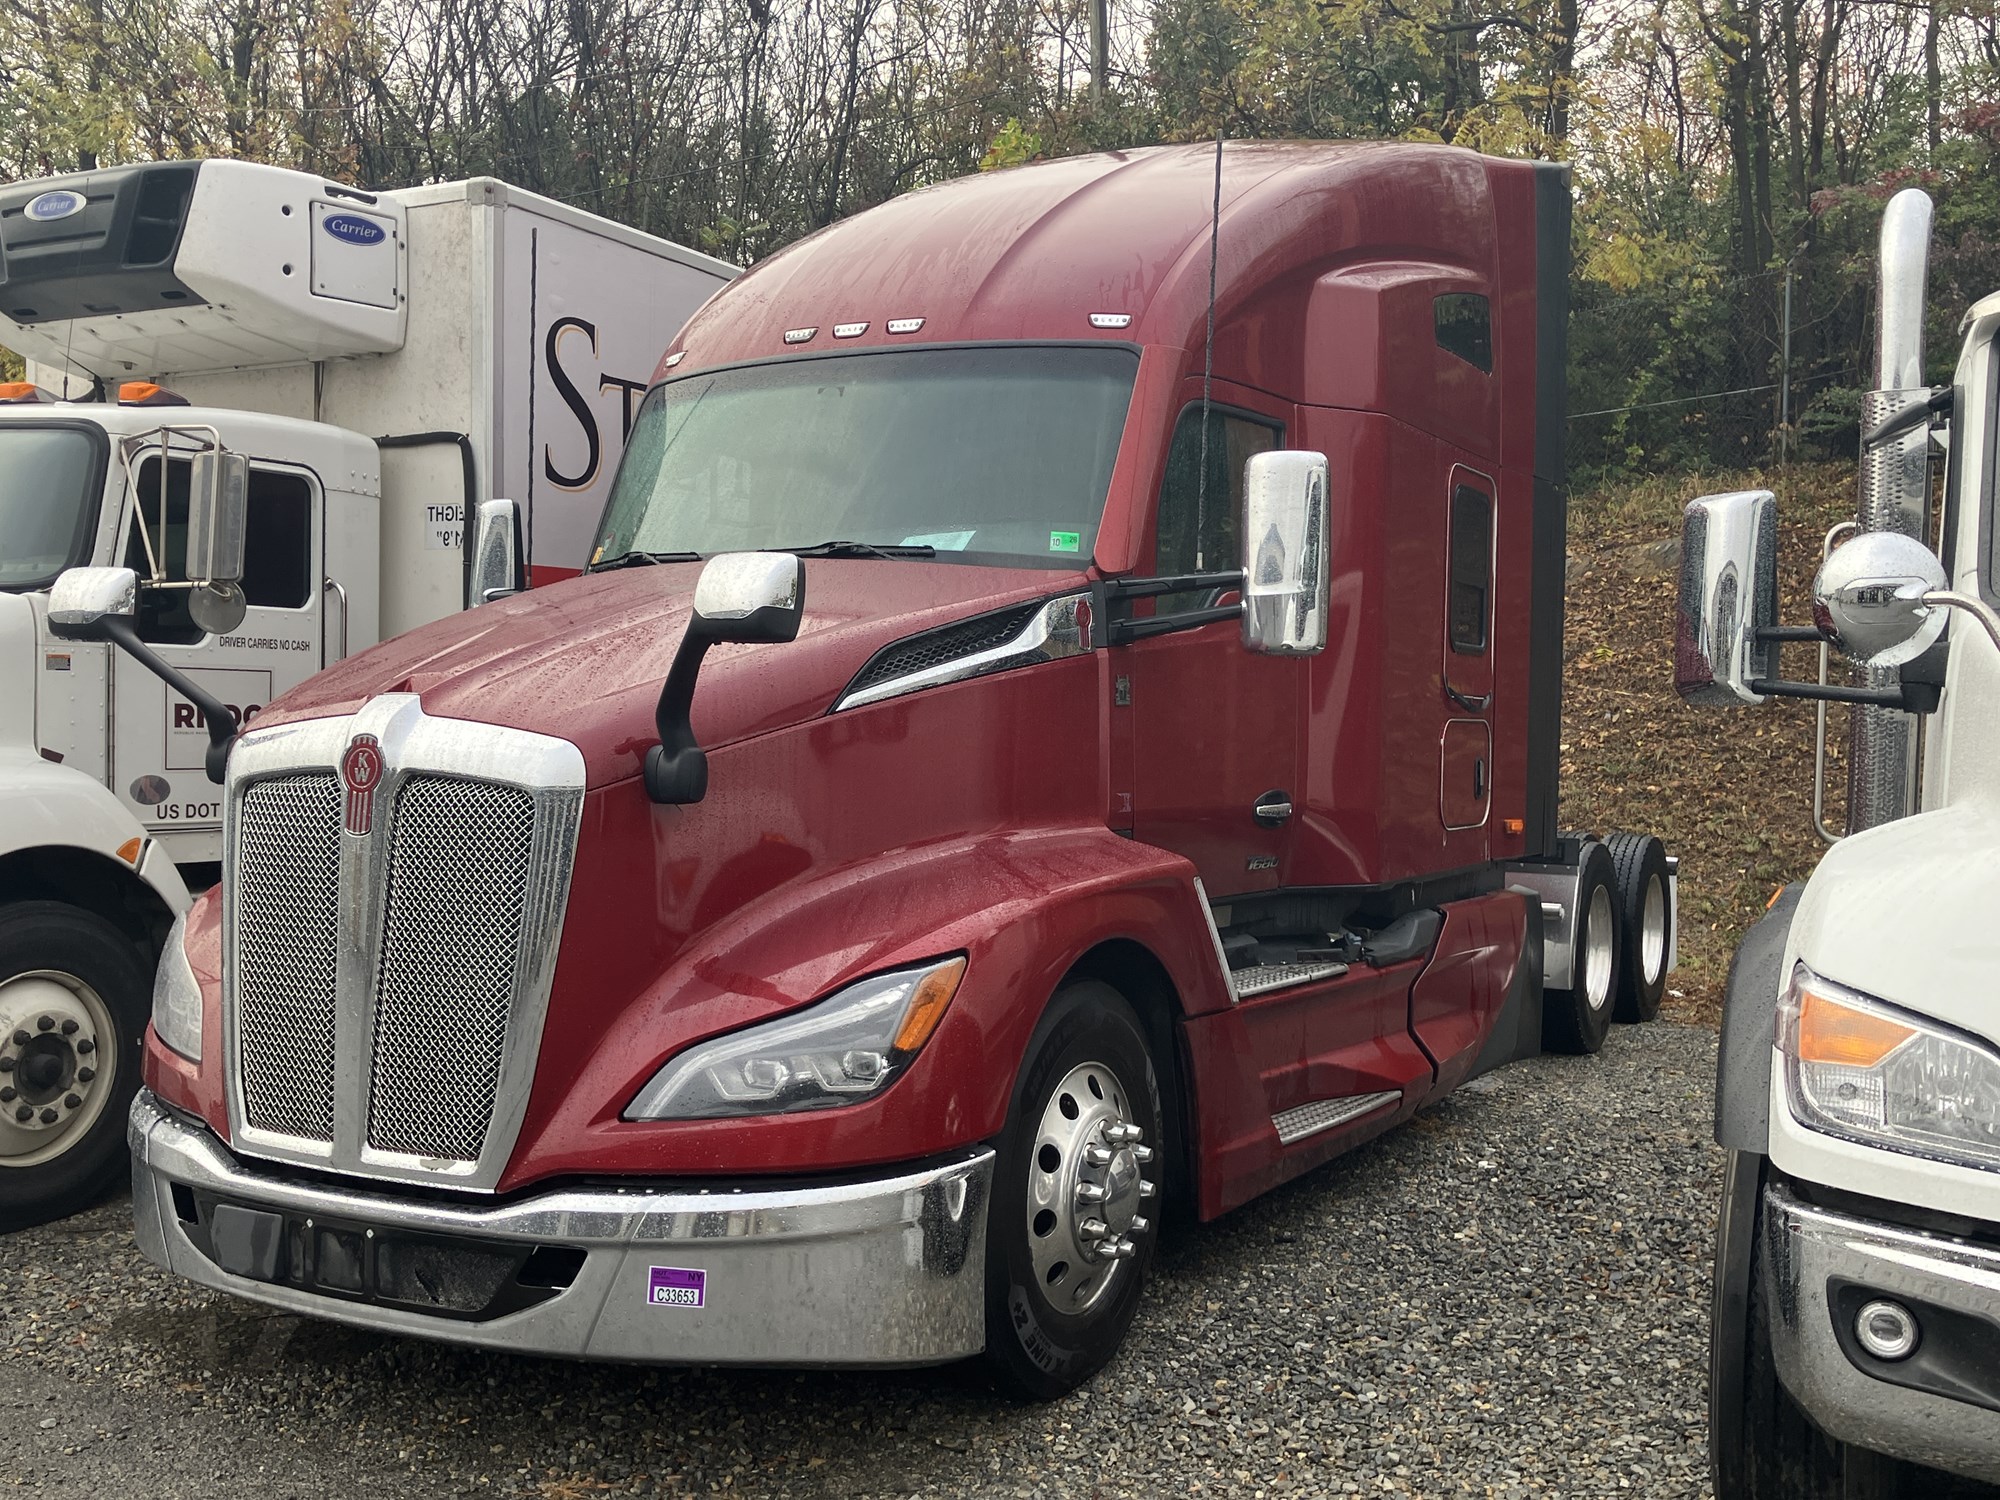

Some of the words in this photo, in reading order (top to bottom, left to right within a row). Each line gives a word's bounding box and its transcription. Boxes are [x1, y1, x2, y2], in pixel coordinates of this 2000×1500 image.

[37, 199, 71, 213] Carrier
[331, 219, 378, 238] Carrier
[1052, 538, 1060, 547] 10
[219, 636, 246, 648] DRIVER
[247, 637, 278, 650] CARRIES
[279, 639, 290, 651] NO
[291, 640, 311, 652] CASH
[156, 803, 179, 820] US
[185, 803, 220, 819] DOT
[688, 1273, 702, 1281] NY
[657, 1288, 695, 1303] C33653
[1023, 1334, 1053, 1369] LINE
